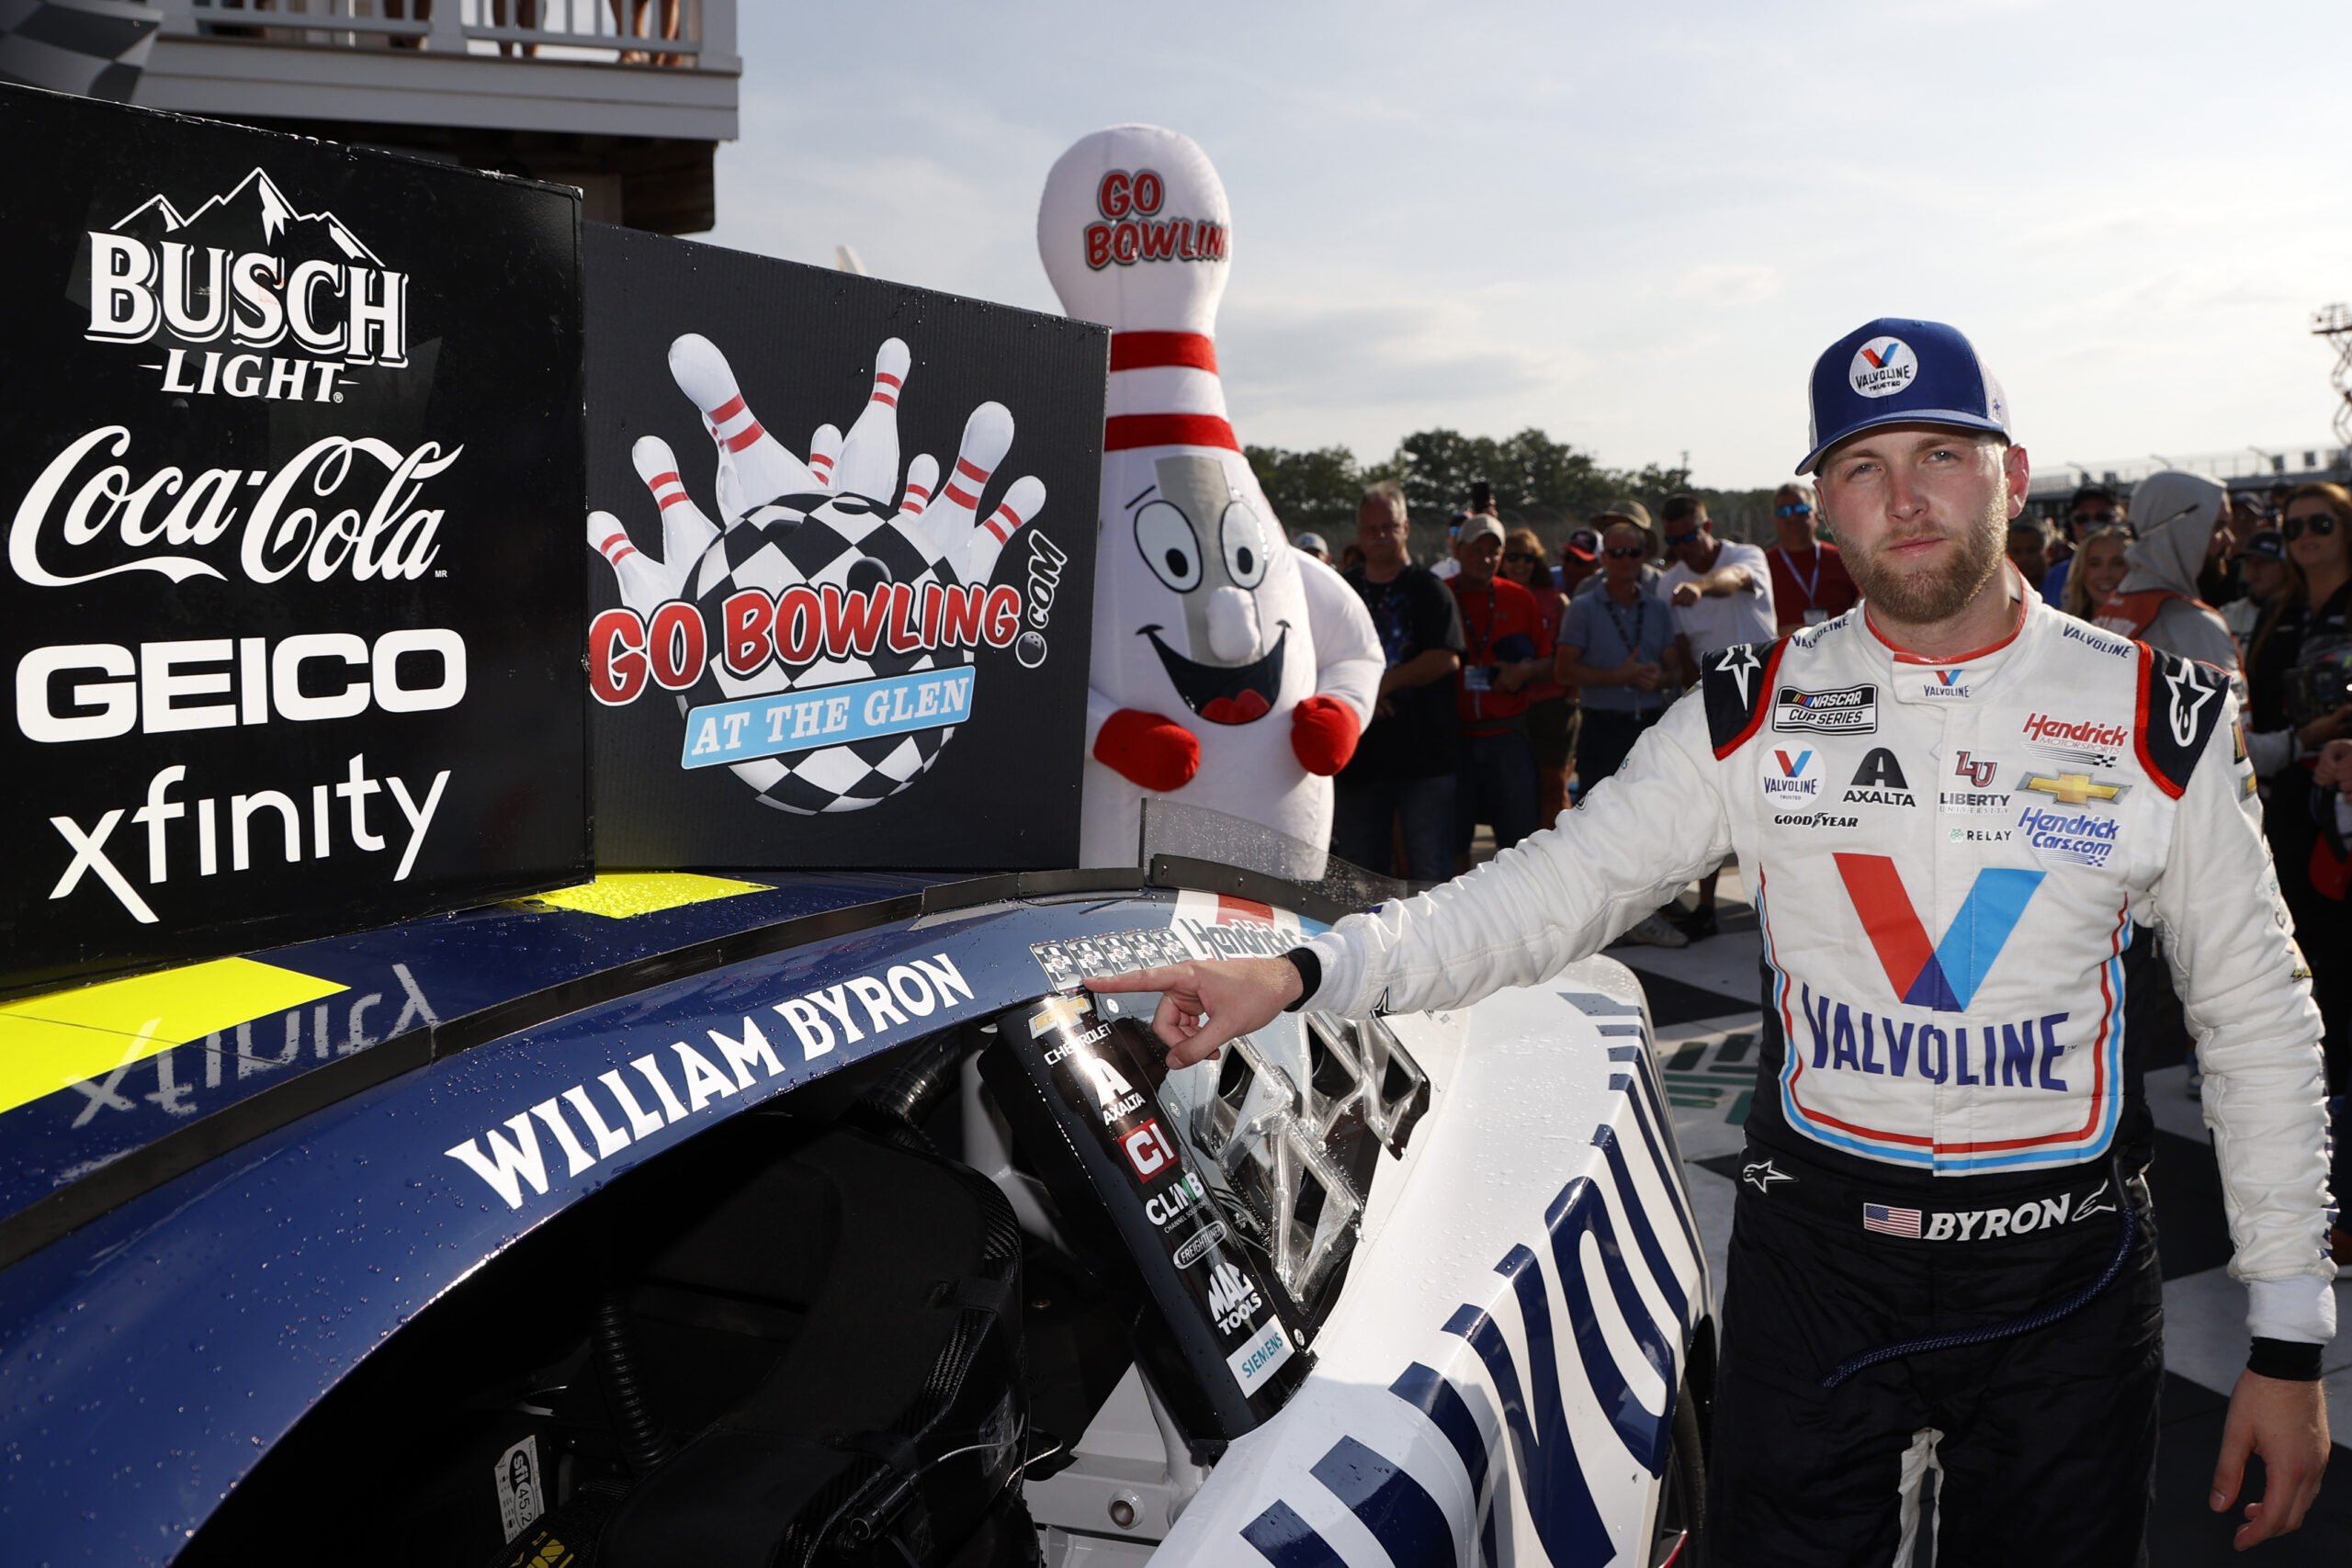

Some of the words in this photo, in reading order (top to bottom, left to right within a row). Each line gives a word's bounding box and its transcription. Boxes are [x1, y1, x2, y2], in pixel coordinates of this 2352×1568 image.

[1097, 169, 1165, 220] GO
[1083, 217, 1228, 271] BOWLIN
[84, 231, 408, 367] BUSCH
[161, 349, 345, 402] LIGHT
[1856, 365, 1910, 389] VALVOLINE
[8, 425, 464, 587] Coca-Cola
[589, 599, 707, 706] GO
[723, 581, 1022, 681] BOWLING
[1792, 617, 1849, 649] VALVOLINE
[2063, 623, 2133, 659] VALVOLINE
[16, 628, 467, 743] GEICO
[1810, 691, 1862, 708] NASCAR
[1924, 684, 1969, 697] VALVOLINE
[691, 712, 750, 755] AT
[766, 695, 850, 743] THE
[864, 677, 970, 726] GLEN
[1789, 709, 1816, 722] CUP
[1816, 711, 1863, 725] SERIES
[2022, 713, 2129, 747] Hendrick
[2040, 737, 2121, 755] MOTORSPORTS
[1764, 776, 1816, 795] VALVOLINE
[1955, 750, 1997, 787] LU
[1843, 790, 1917, 807] AXALTA
[1939, 792, 2010, 807] LIBERTY
[1939, 806, 2009, 815] UNIVERSITY
[48, 753, 451, 924] xfinity
[1774, 812, 1858, 828] GOODYEAR
[1967, 830, 2012, 841] RELAY
[2018, 807, 2120, 840] Hendrick
[2032, 831, 2113, 857] Cars.com
[1044, 1023, 1112, 1065] CHEROLET
[1802, 981, 2070, 1092] VALVOLINE
[444, 1016, 786, 1210] WILLIAM
[774, 953, 975, 1061] BYRON
[1102, 1092, 1147, 1126] AXALTA
[1145, 1172, 1204, 1225] CLIMB
[1164, 1216, 1187, 1234] CHANNEL
[1922, 1193, 2071, 1242] BYRON
[1181, 1225, 1221, 1264] FREIGHTLINER
[1207, 1262, 1256, 1323] MAC
[1218, 1293, 1262, 1337] TOOLS
[1241, 1332, 1283, 1379] SIEMENS
[517, 1489, 534, 1527] 45.2
